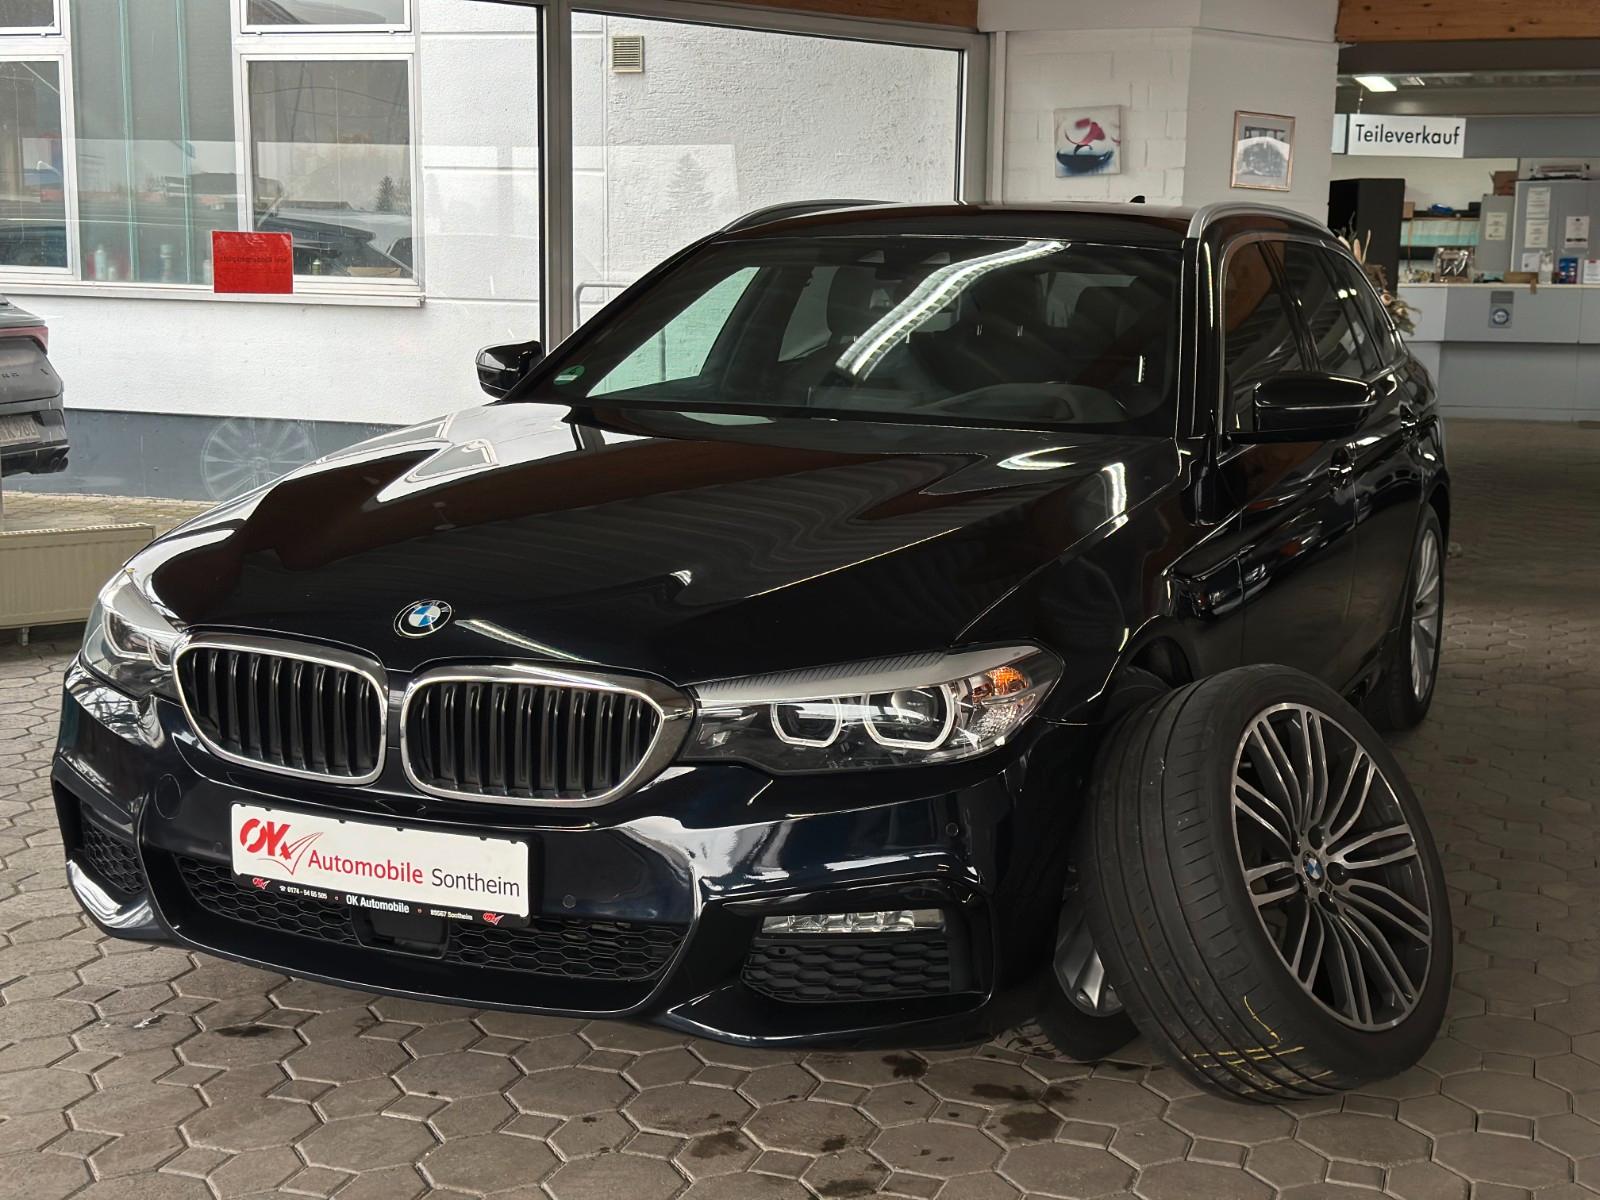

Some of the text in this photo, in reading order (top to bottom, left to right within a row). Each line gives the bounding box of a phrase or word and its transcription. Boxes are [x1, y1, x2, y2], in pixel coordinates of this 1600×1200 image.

[1355, 123, 1460, 145] Teileverkauf
[239, 818, 291, 860] OK
[308, 849, 520, 898] Automobile Sontheim
[345, 894, 410, 914] OK Automobile
[447, 910, 474, 920] Sontheim
